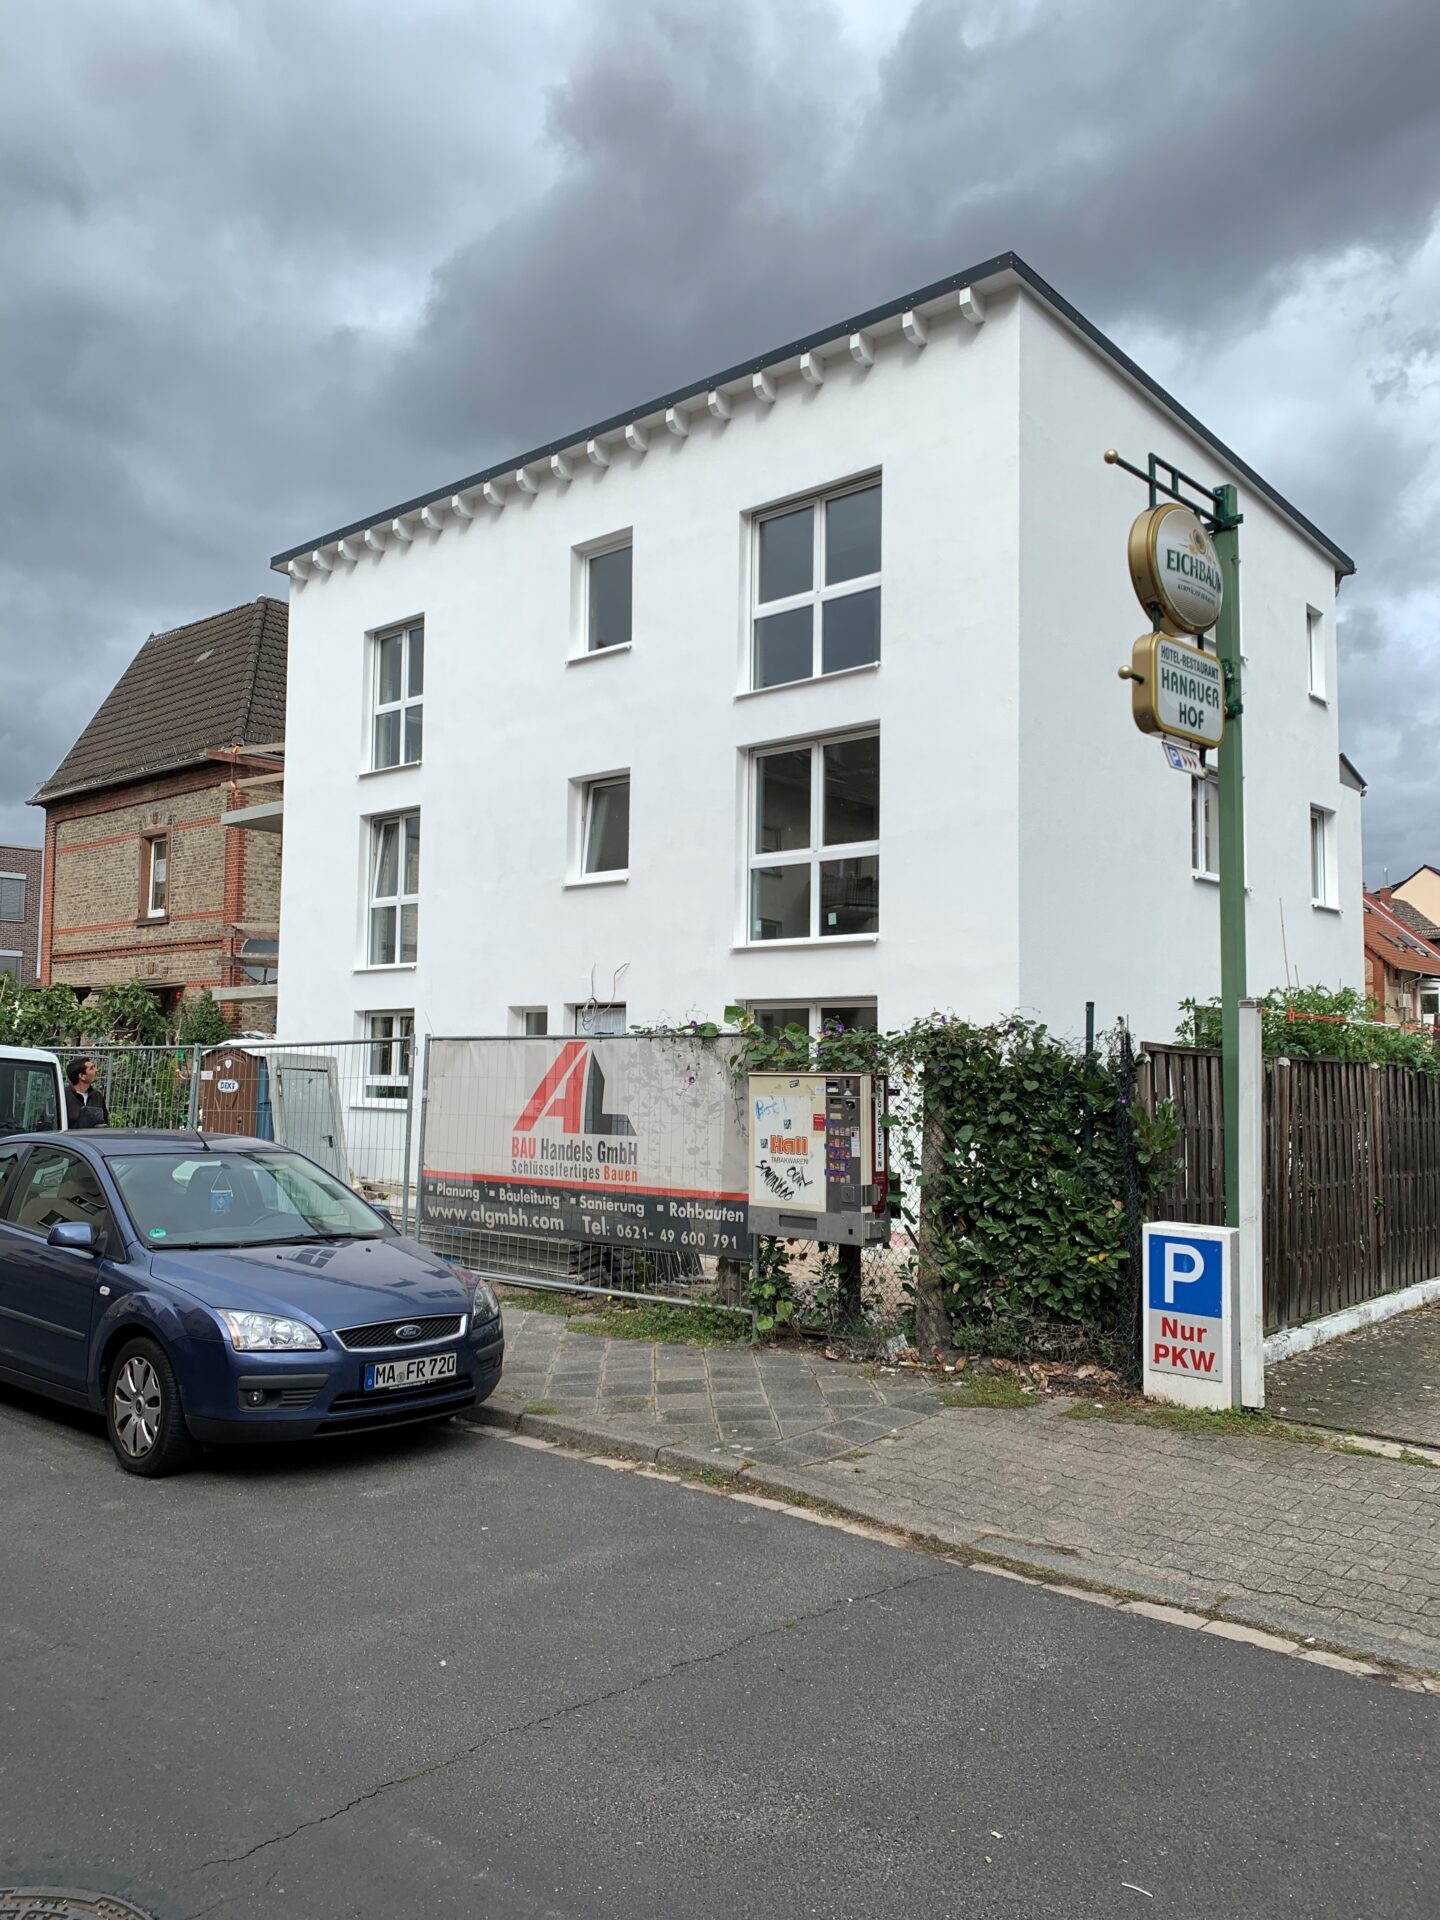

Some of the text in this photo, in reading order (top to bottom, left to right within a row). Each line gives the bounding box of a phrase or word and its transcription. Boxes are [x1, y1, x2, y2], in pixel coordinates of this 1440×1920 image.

[1161, 645, 1220, 681] HOTEL-RESTAURANT
[1161, 667, 1220, 710] HANAUER
[1179, 702, 1205, 729] HOF
[511, 1136, 638, 1165] BAU Handels GmbH
[770, 1134, 808, 1155] Hall
[511, 1159, 638, 1182] Schlüsselfertiges Bauen
[436, 1182, 744, 1223] Planung Bauleitung Sanierung Rohbauten
[428, 1204, 565, 1231] www.algmbh.com
[582, 1216, 611, 1236] Tel:
[660, 1229, 675, 1242] 49
[680, 1231, 706, 1247] 600
[713, 1234, 737, 1249] 791
[1164, 1242, 1205, 1304] P
[1161, 1316, 1208, 1343] Nur
[375, 1365, 396, 1385] MA
[406, 1360, 426, 1380] FR
[429, 1355, 455, 1376] 720
[1153, 1343, 1216, 1373] PKW
